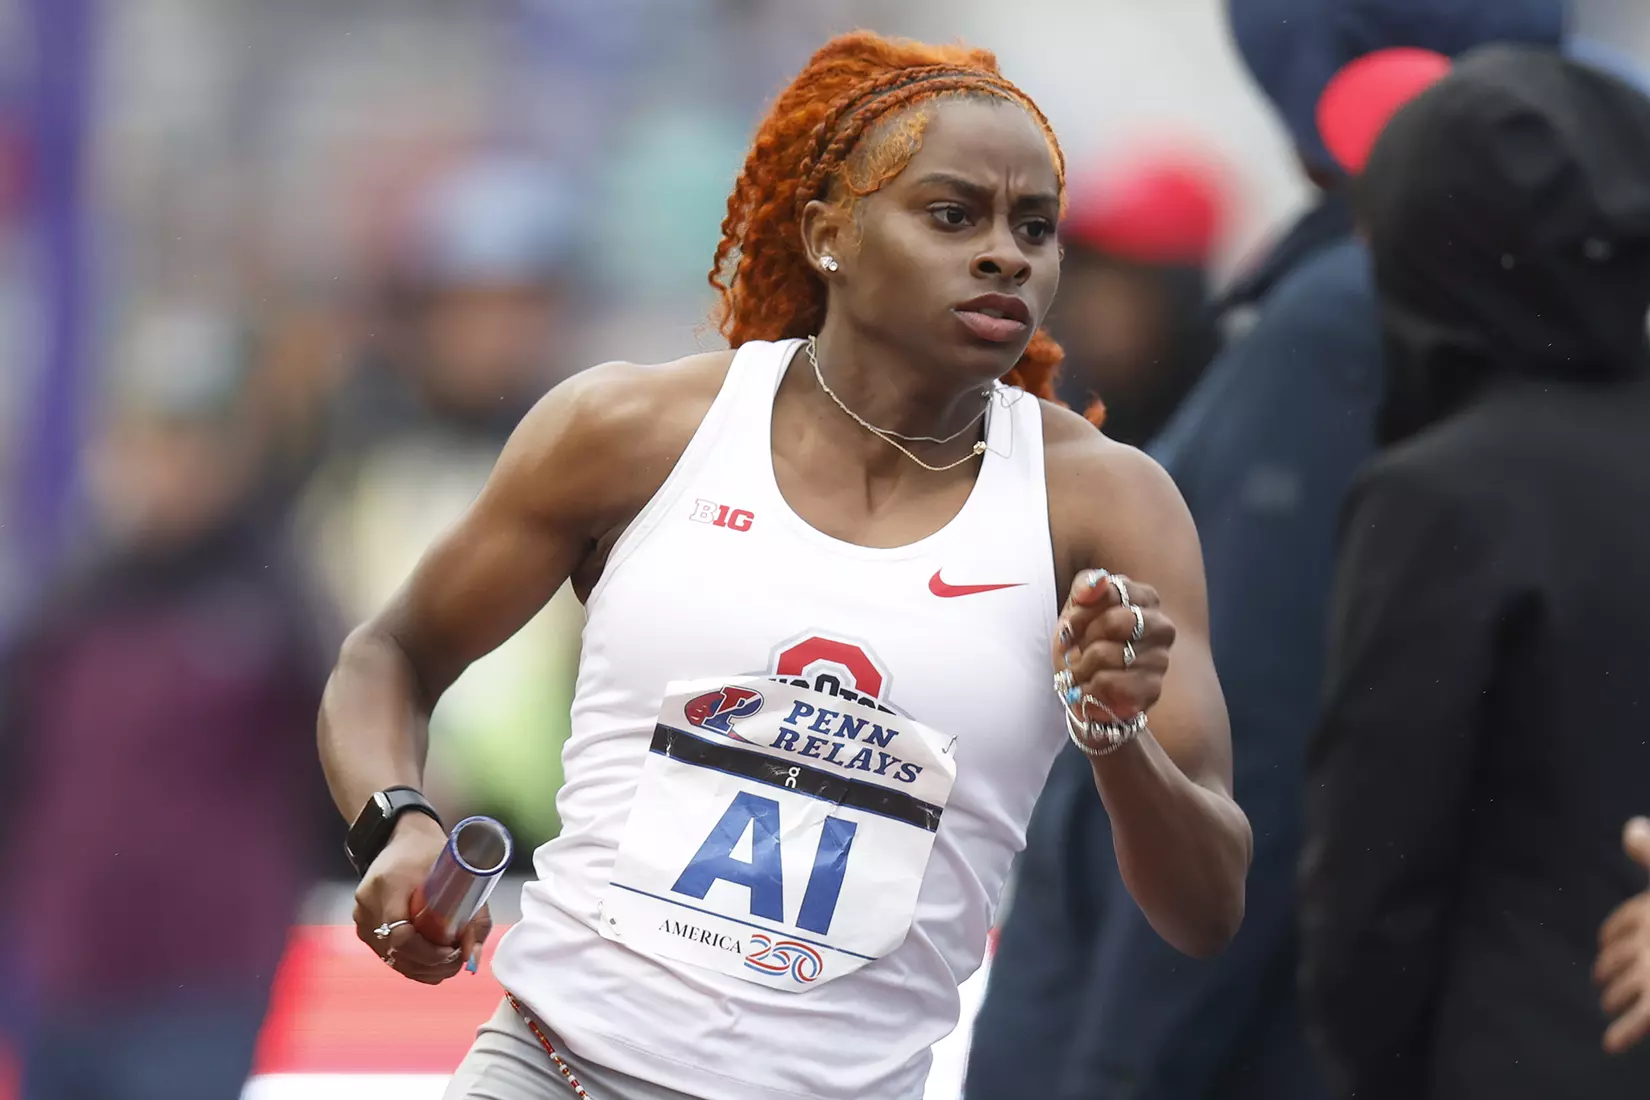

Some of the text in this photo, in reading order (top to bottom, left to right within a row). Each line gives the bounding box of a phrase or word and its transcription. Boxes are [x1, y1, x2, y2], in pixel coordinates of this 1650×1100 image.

[783, 699, 899, 748] PENN
[769, 726, 924, 784] RELAYS
[671, 790, 858, 936] AI
[659, 918, 823, 984] AMERICA 250
